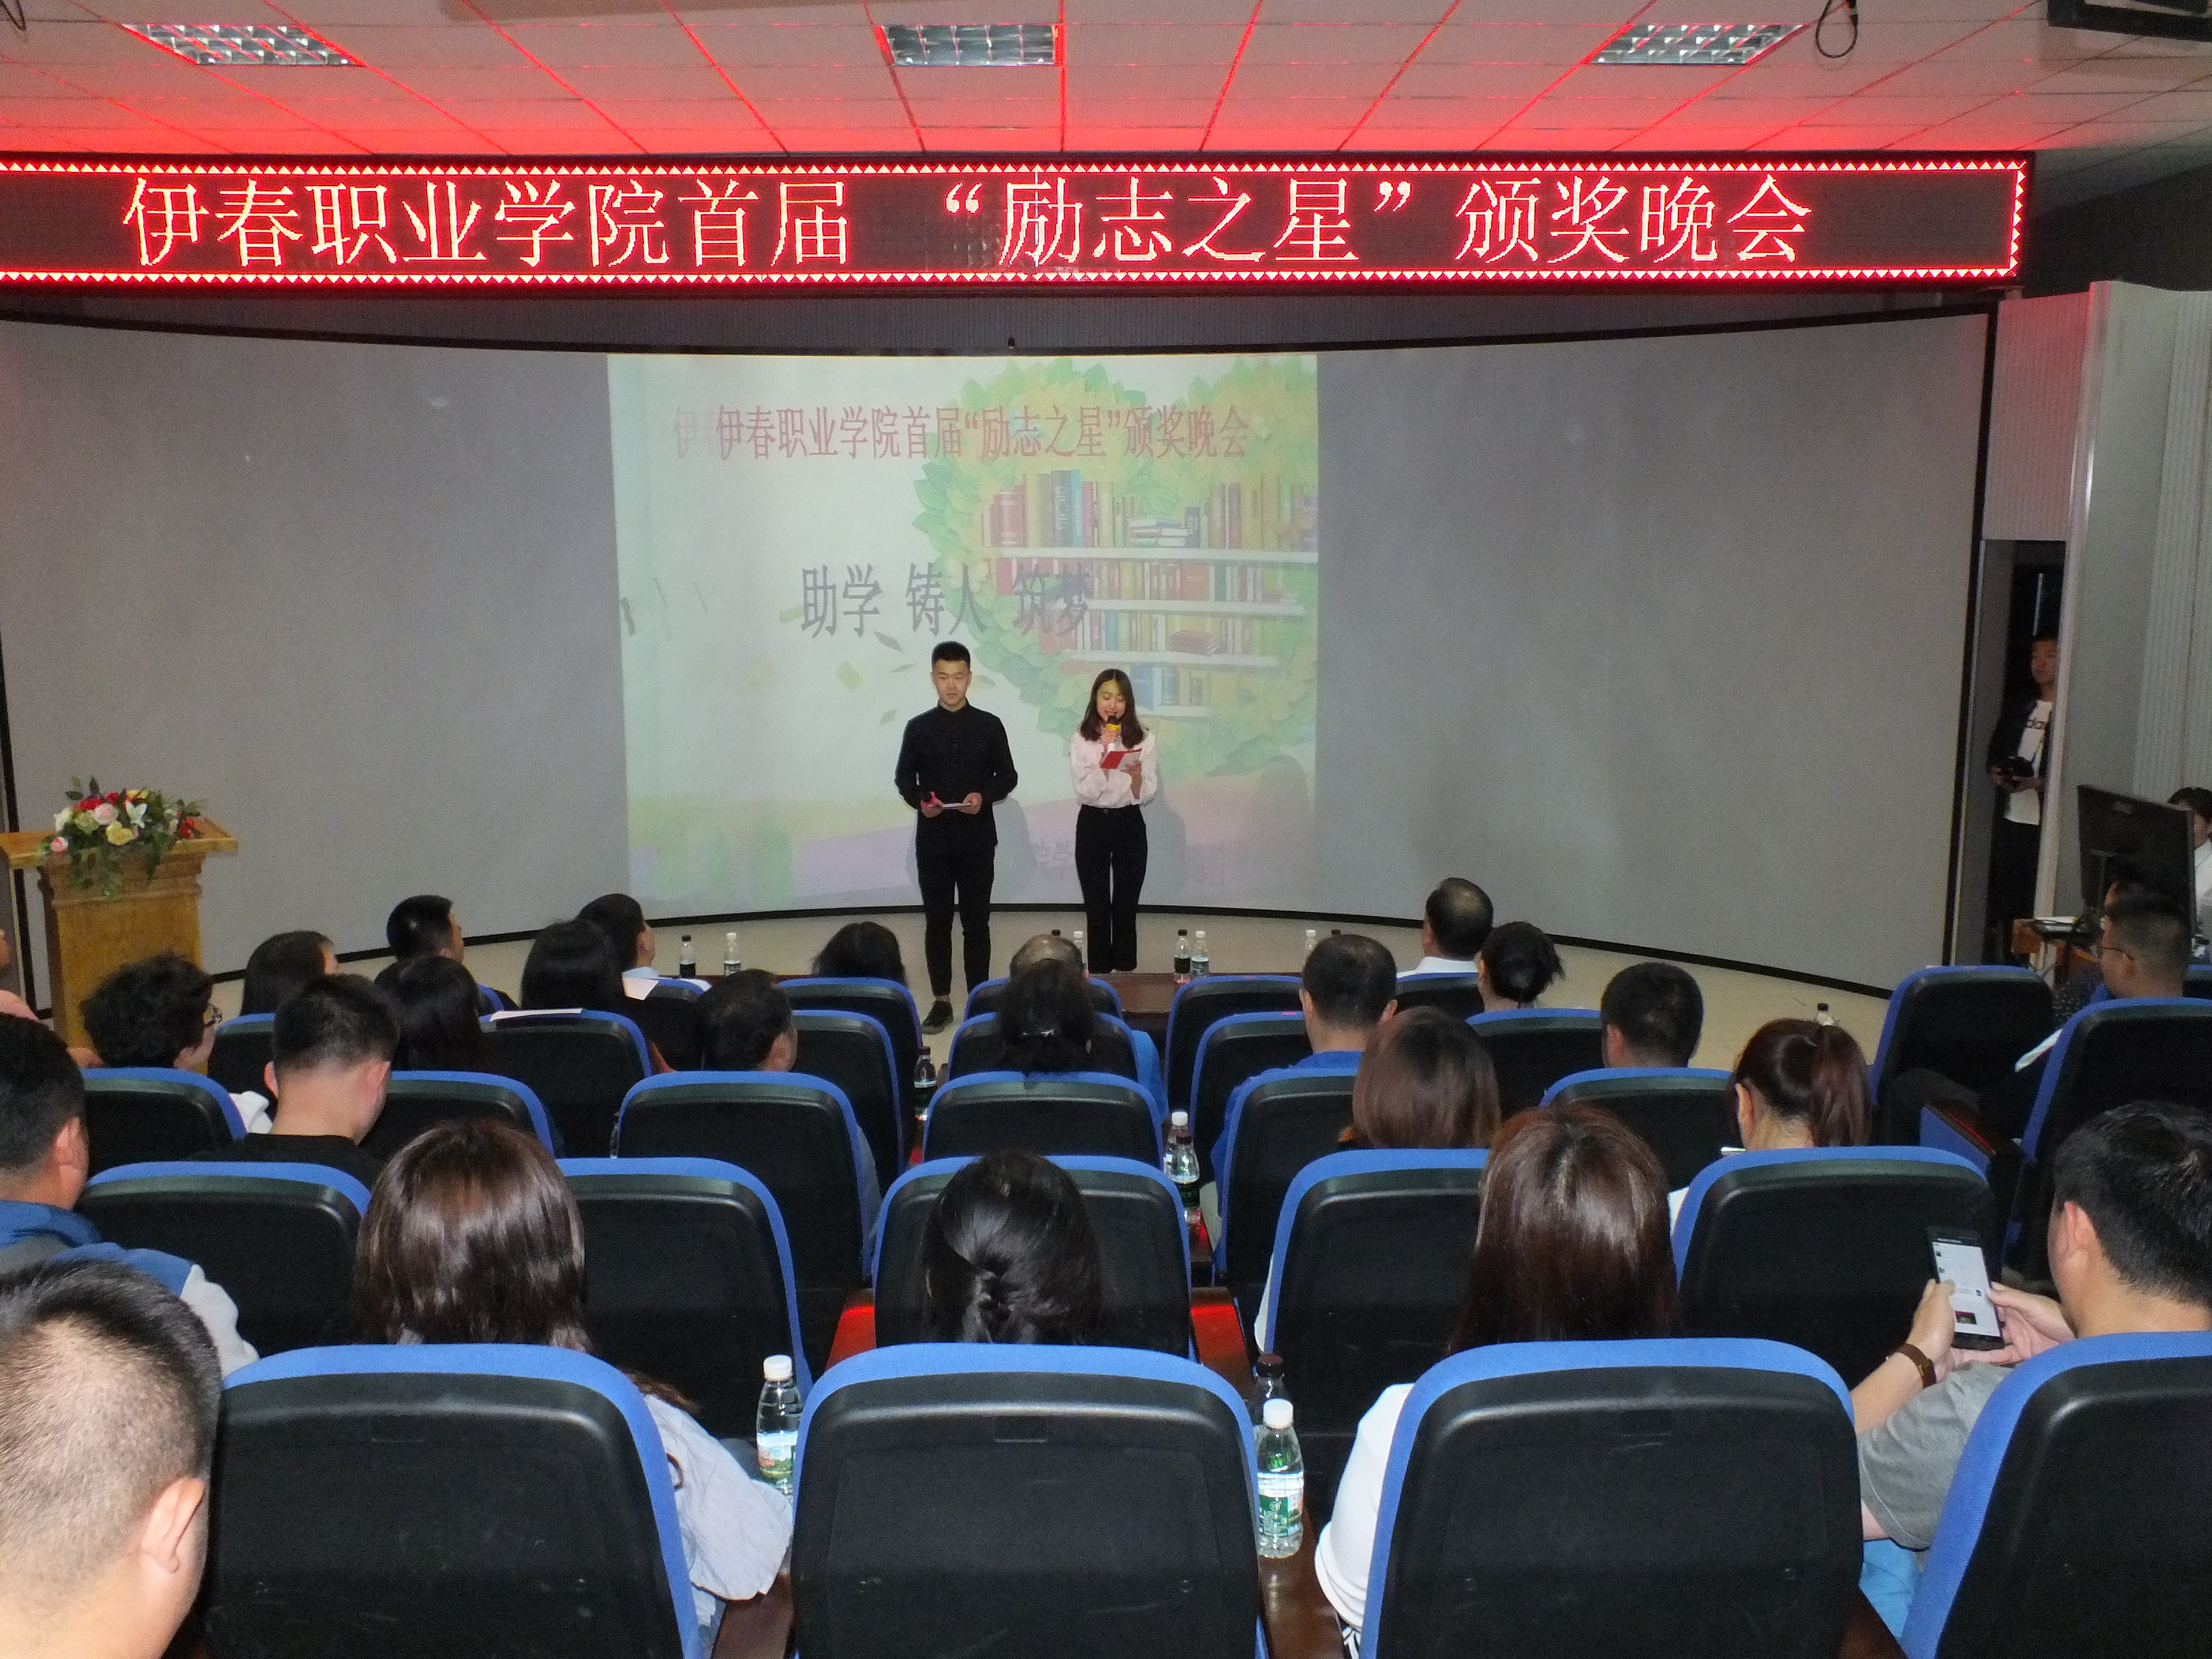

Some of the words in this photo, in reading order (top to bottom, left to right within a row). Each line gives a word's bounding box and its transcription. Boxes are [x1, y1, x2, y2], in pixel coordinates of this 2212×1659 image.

[123, 177, 849, 267] 伊春职业学院首届
[801, 564, 882, 639] 助学
